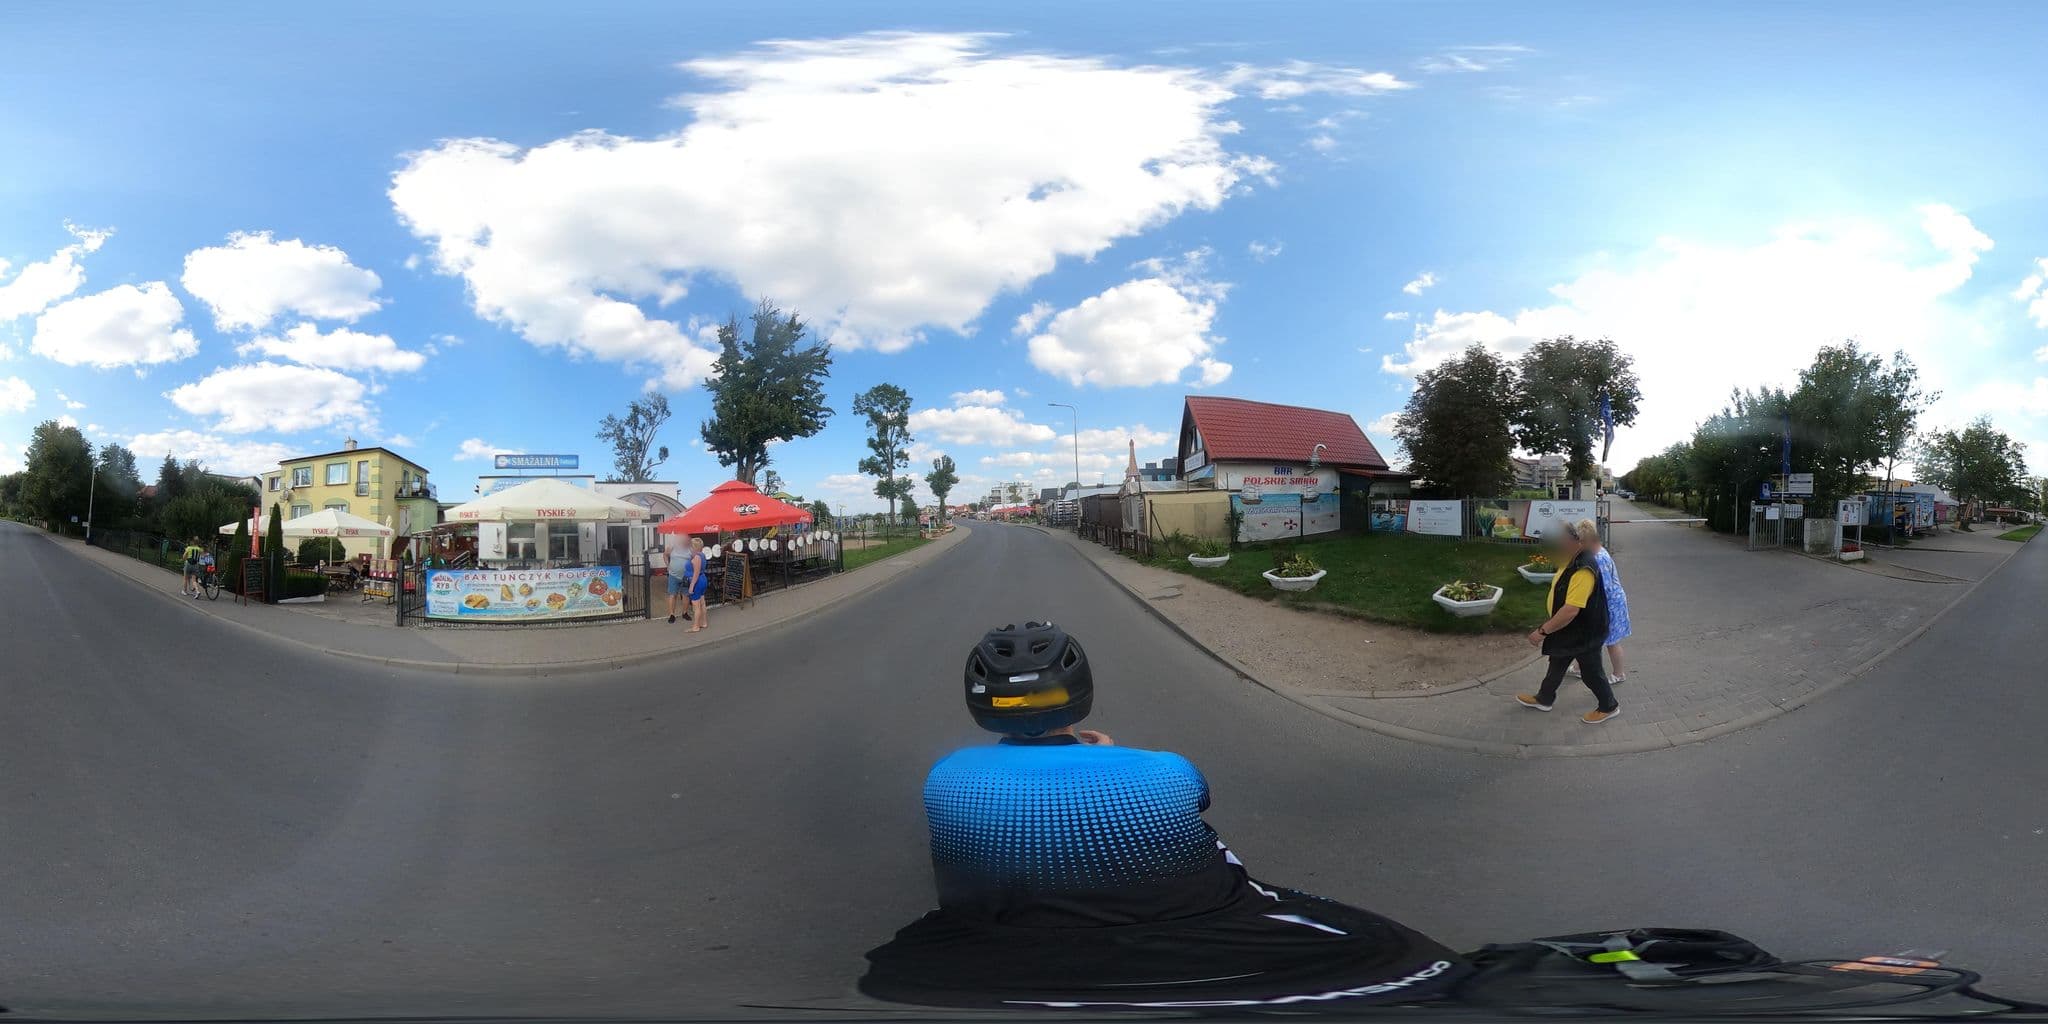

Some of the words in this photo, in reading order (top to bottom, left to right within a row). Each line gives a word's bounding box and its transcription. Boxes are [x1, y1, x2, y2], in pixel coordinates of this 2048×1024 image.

[511, 455, 560, 466] SMAŻALNIA
[1274, 466, 1293, 476] BAR
[1243, 476, 1288, 486] POLSKIE
[536, 508, 565, 518] TYSKIE
[464, 573, 488, 581] BAR
[493, 571, 551, 581] TUŃCZYK
[436, 582, 450, 590] RYB
